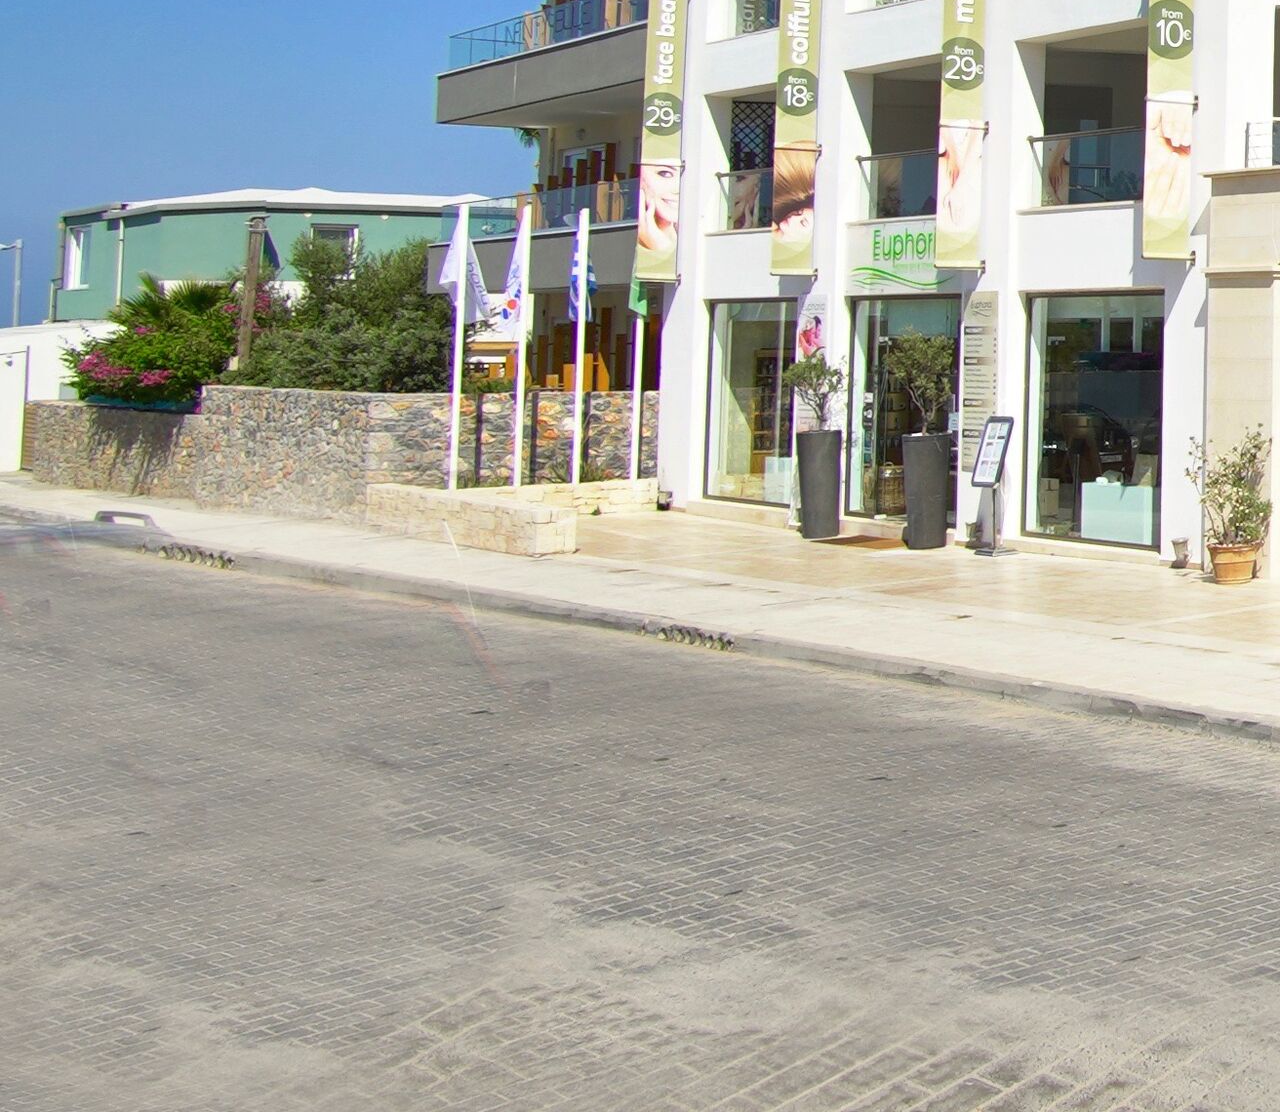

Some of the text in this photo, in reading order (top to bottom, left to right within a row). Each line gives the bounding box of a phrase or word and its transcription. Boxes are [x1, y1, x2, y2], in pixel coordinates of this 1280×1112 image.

[1161, 8, 1183, 19] from
[1156, 19, 1192, 48] 10€
[954, 45, 974, 56] from
[653, 41, 675, 85] face
[944, 55, 984, 81] 29€
[788, 75, 807, 84] from
[653, 98, 672, 107] from
[783, 85, 815, 108] 18€
[645, 106, 681, 128] 29€
